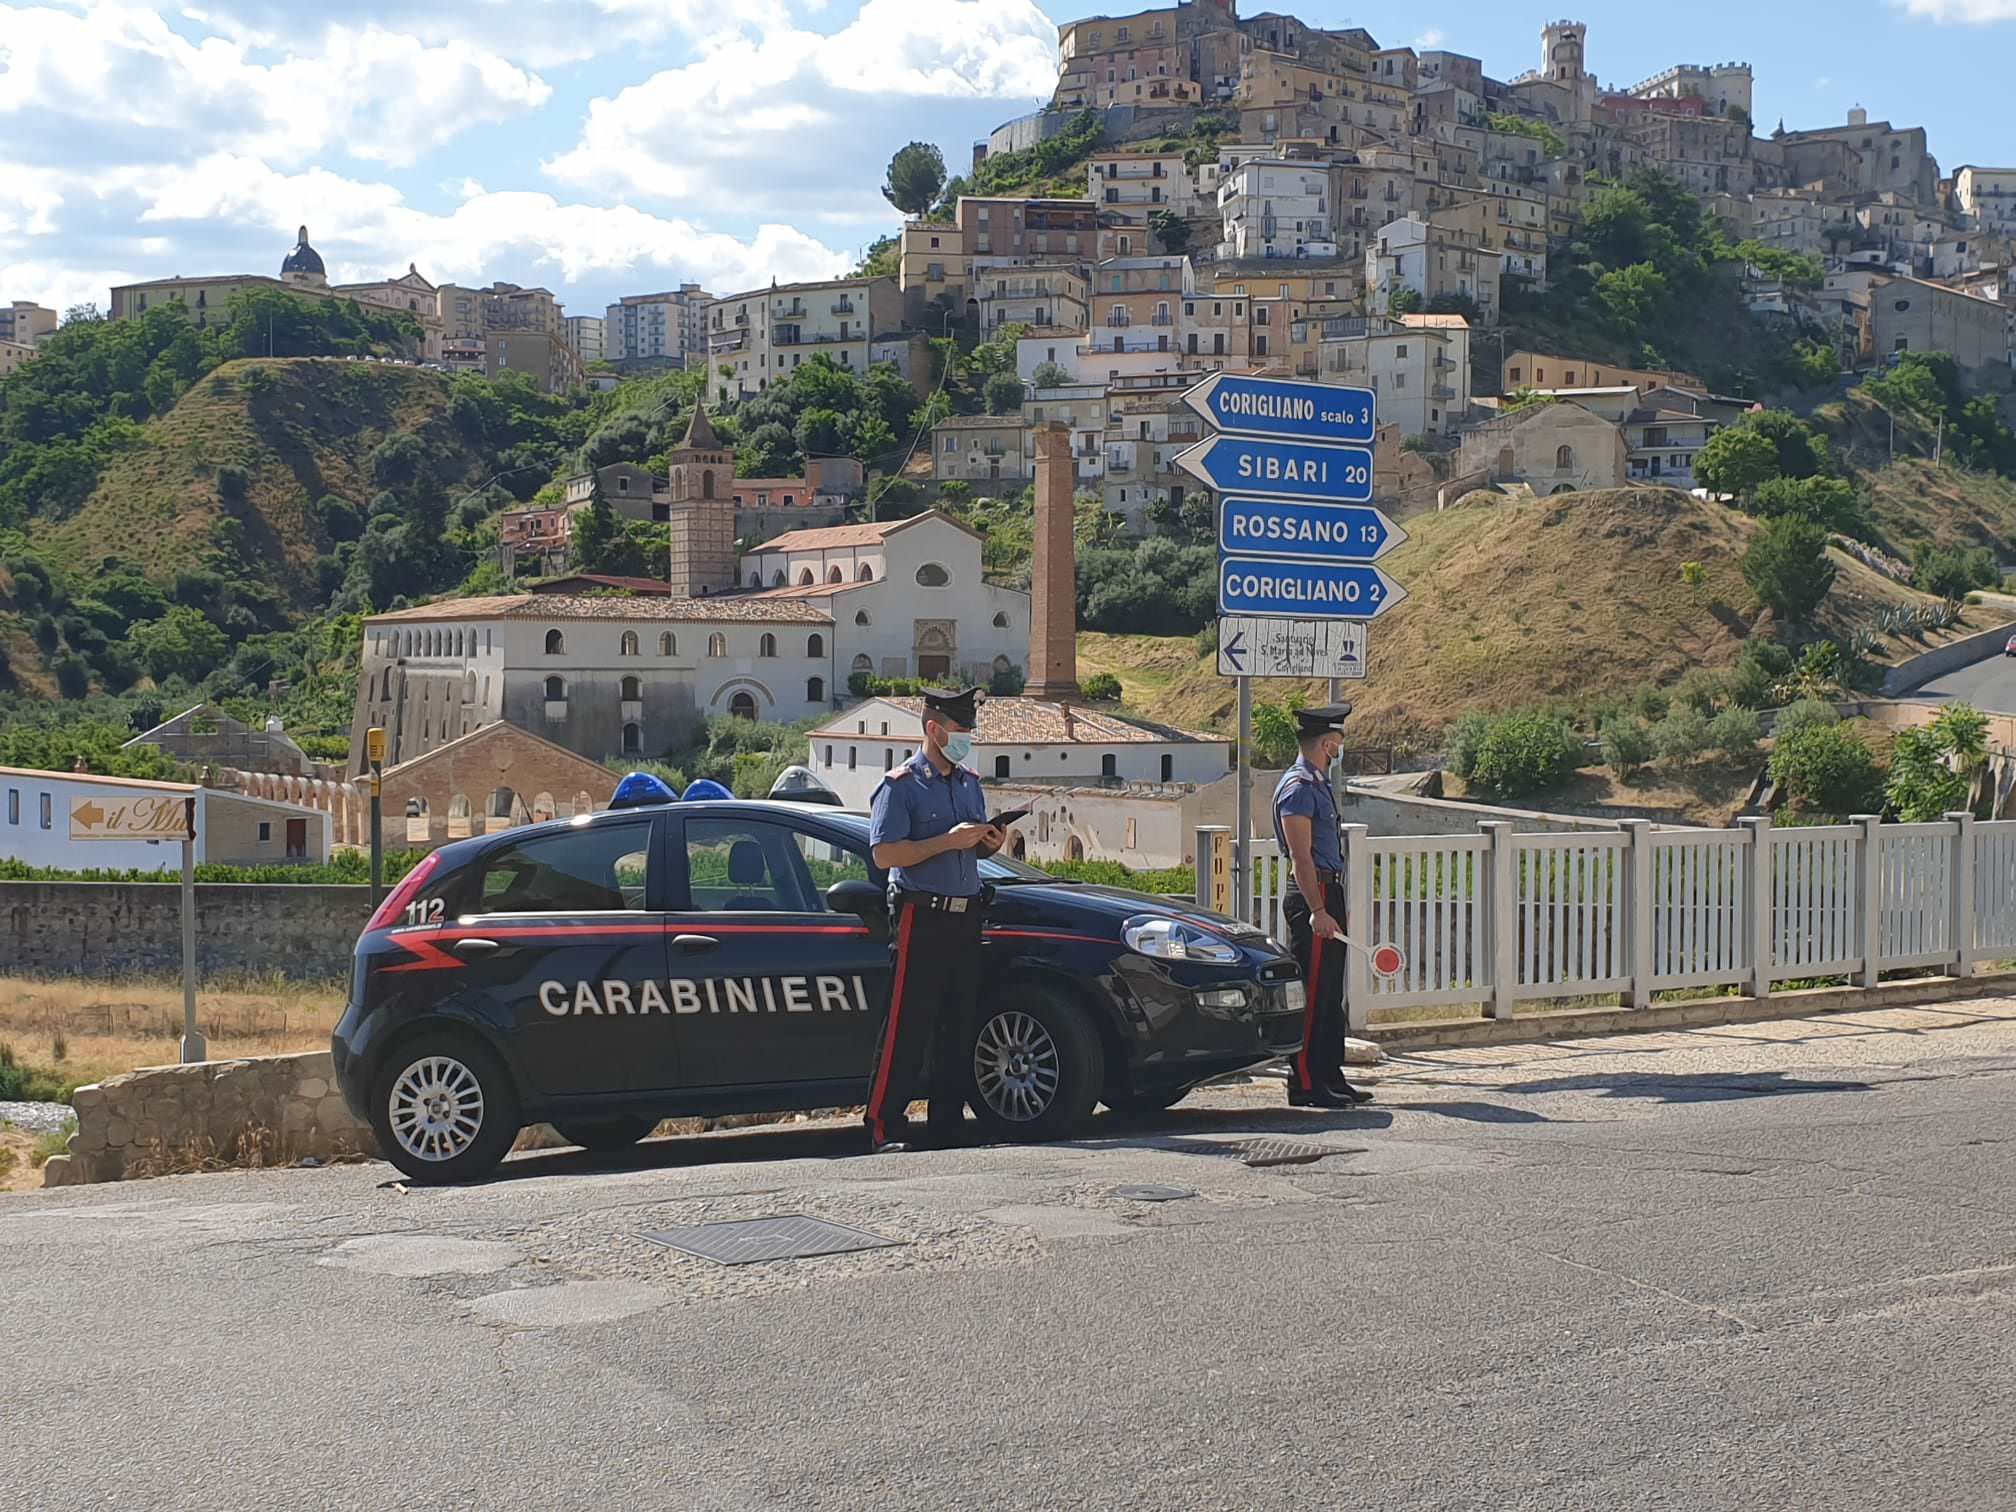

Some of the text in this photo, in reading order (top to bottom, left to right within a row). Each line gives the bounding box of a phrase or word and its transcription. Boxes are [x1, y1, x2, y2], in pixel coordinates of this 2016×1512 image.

[1219, 391, 1369, 425] CORIGLIANO scalo 3
[1238, 454, 1367, 484] SIBARI 20
[1233, 514, 1377, 543] ROSSANO 13
[1226, 574, 1380, 602] CORIGLIANO 2
[405, 897, 445, 926] 112
[538, 975, 868, 1016] CARABINIERI
